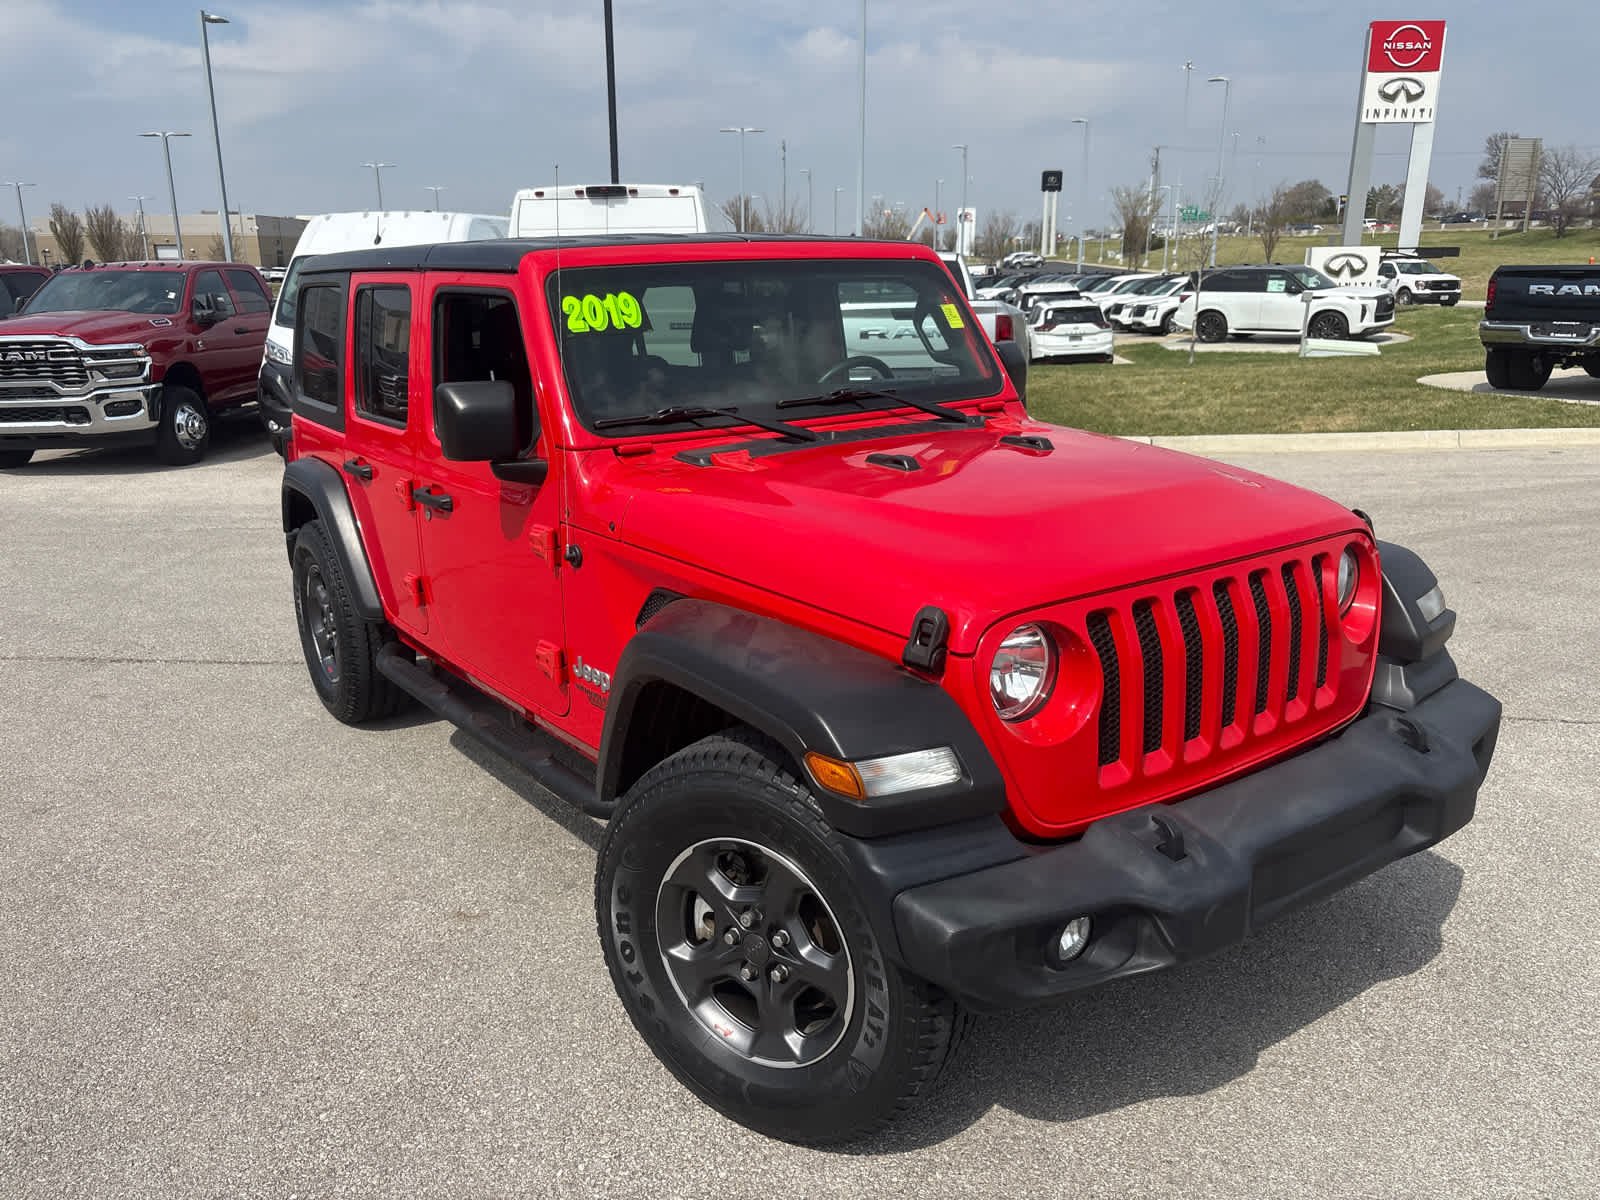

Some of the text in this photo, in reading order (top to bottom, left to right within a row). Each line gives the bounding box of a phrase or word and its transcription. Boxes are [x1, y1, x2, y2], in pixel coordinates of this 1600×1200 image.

[1383, 41, 1432, 50] NISSAN
[1365, 107, 1433, 119] INFINITI
[562, 291, 642, 333] 2019
[0, 351, 46, 361] AM
[573, 655, 611, 694] Jeep
